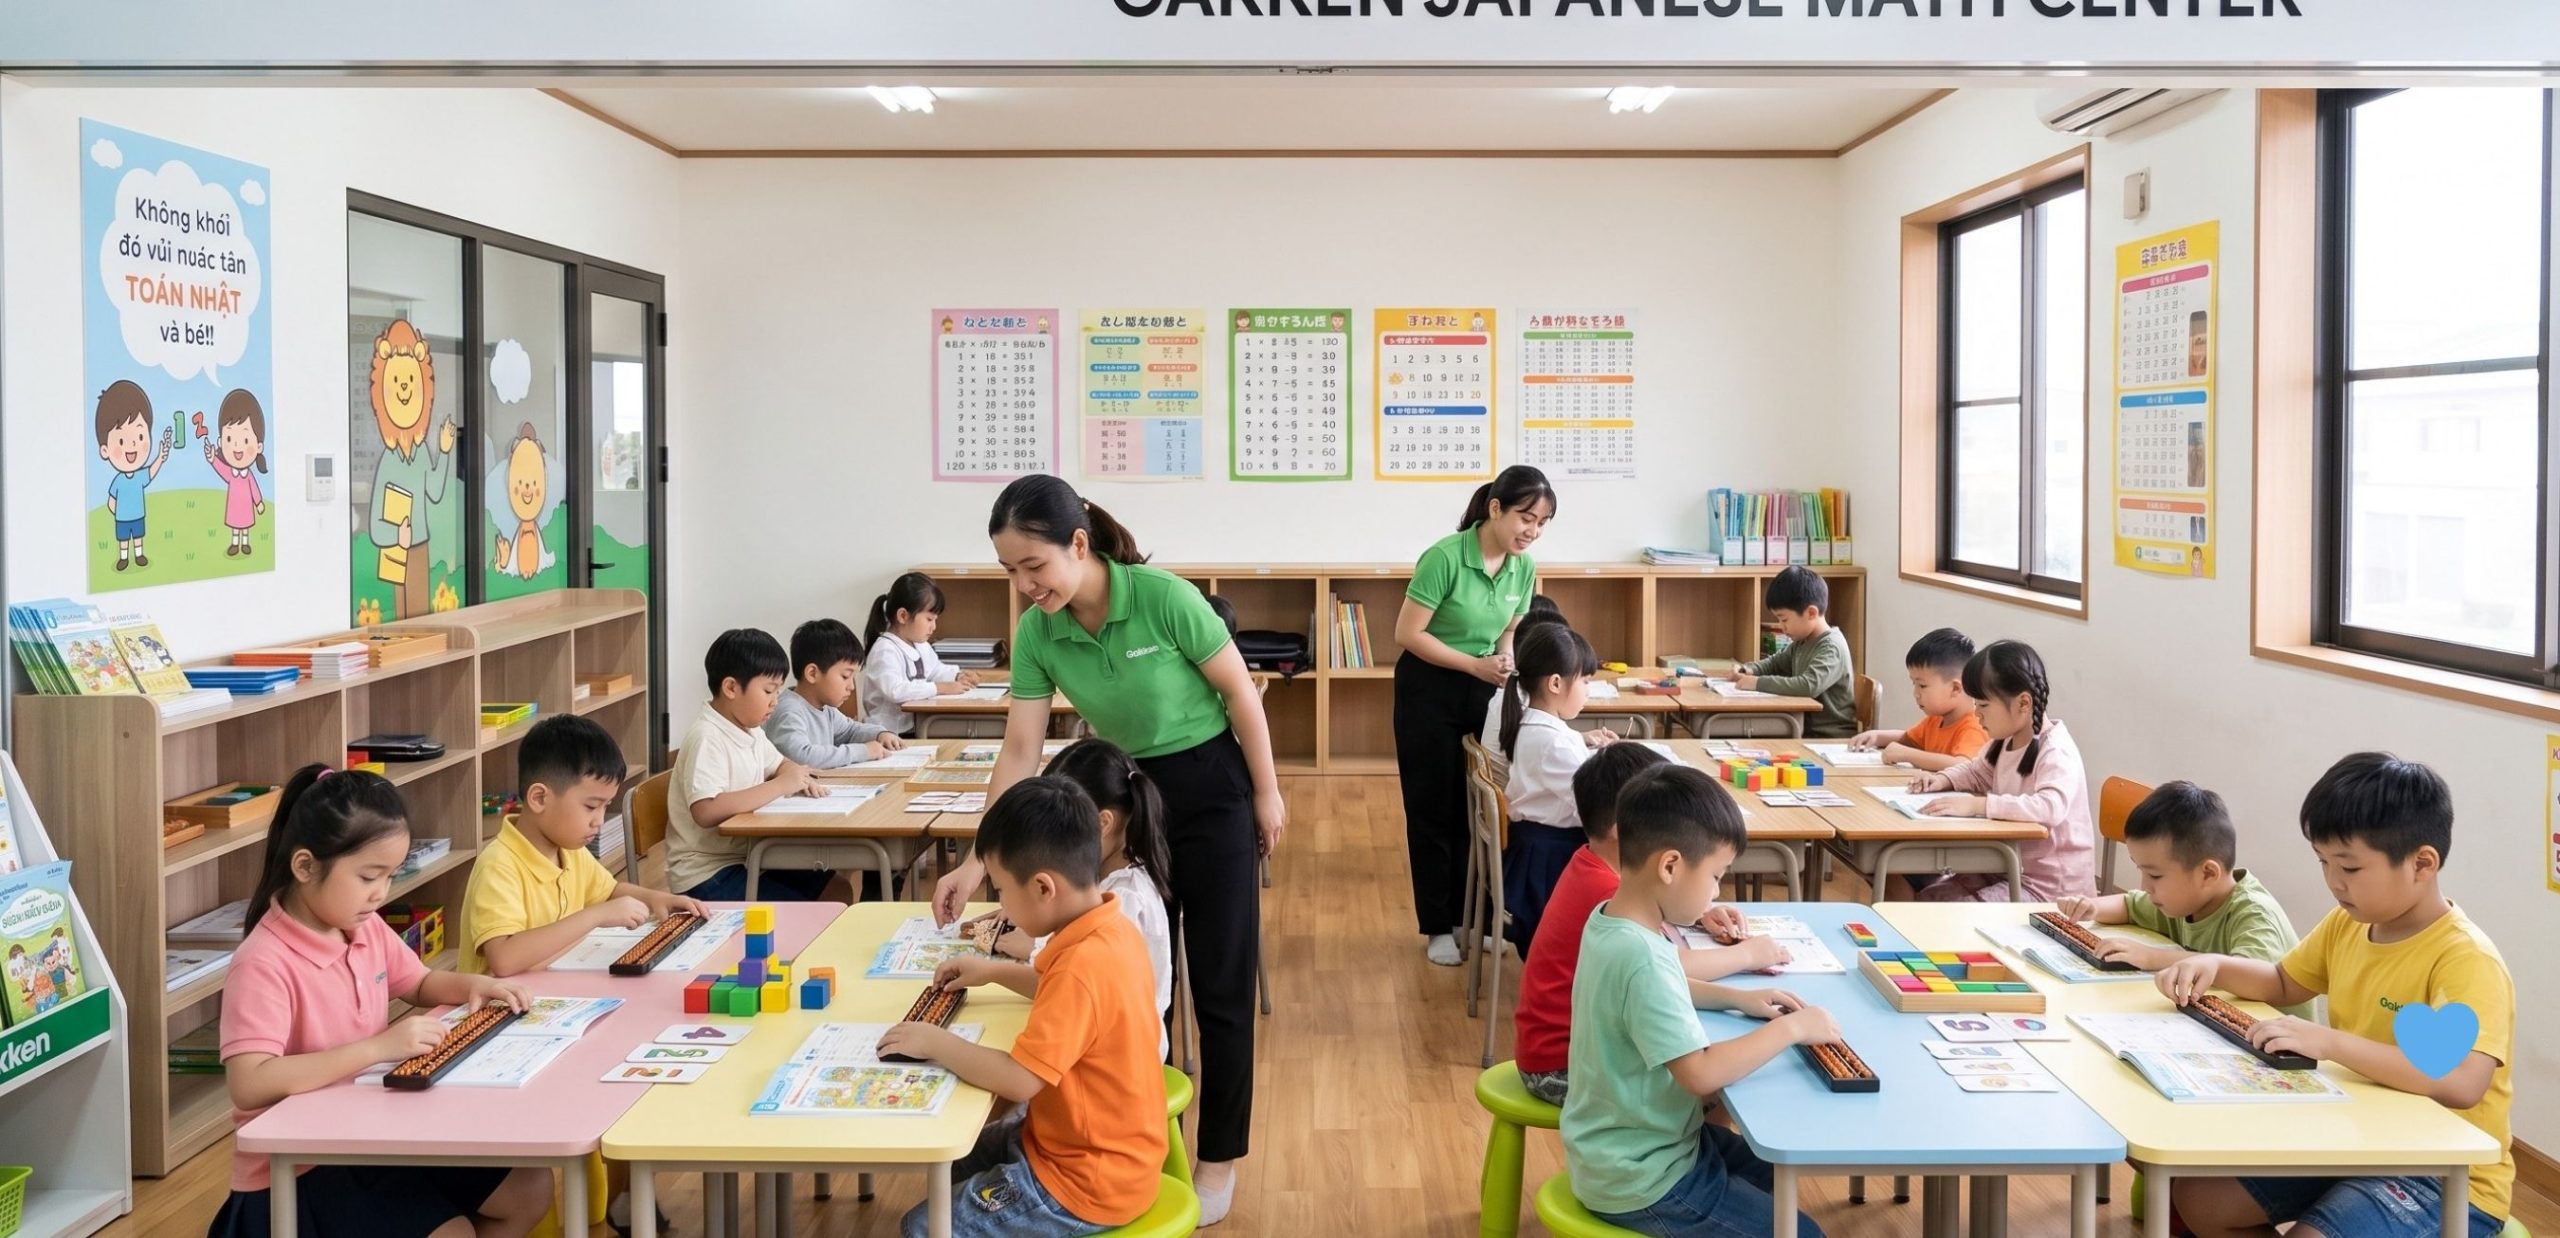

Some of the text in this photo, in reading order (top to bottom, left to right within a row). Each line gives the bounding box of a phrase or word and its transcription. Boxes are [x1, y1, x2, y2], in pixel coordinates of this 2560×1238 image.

[135, 197, 190, 233] Không
[119, 233, 141, 258] đó
[220, 251, 246, 275] tân
[126, 273, 241, 319] TOÁN NHẬT
[160, 320, 214, 346] và bé!!
